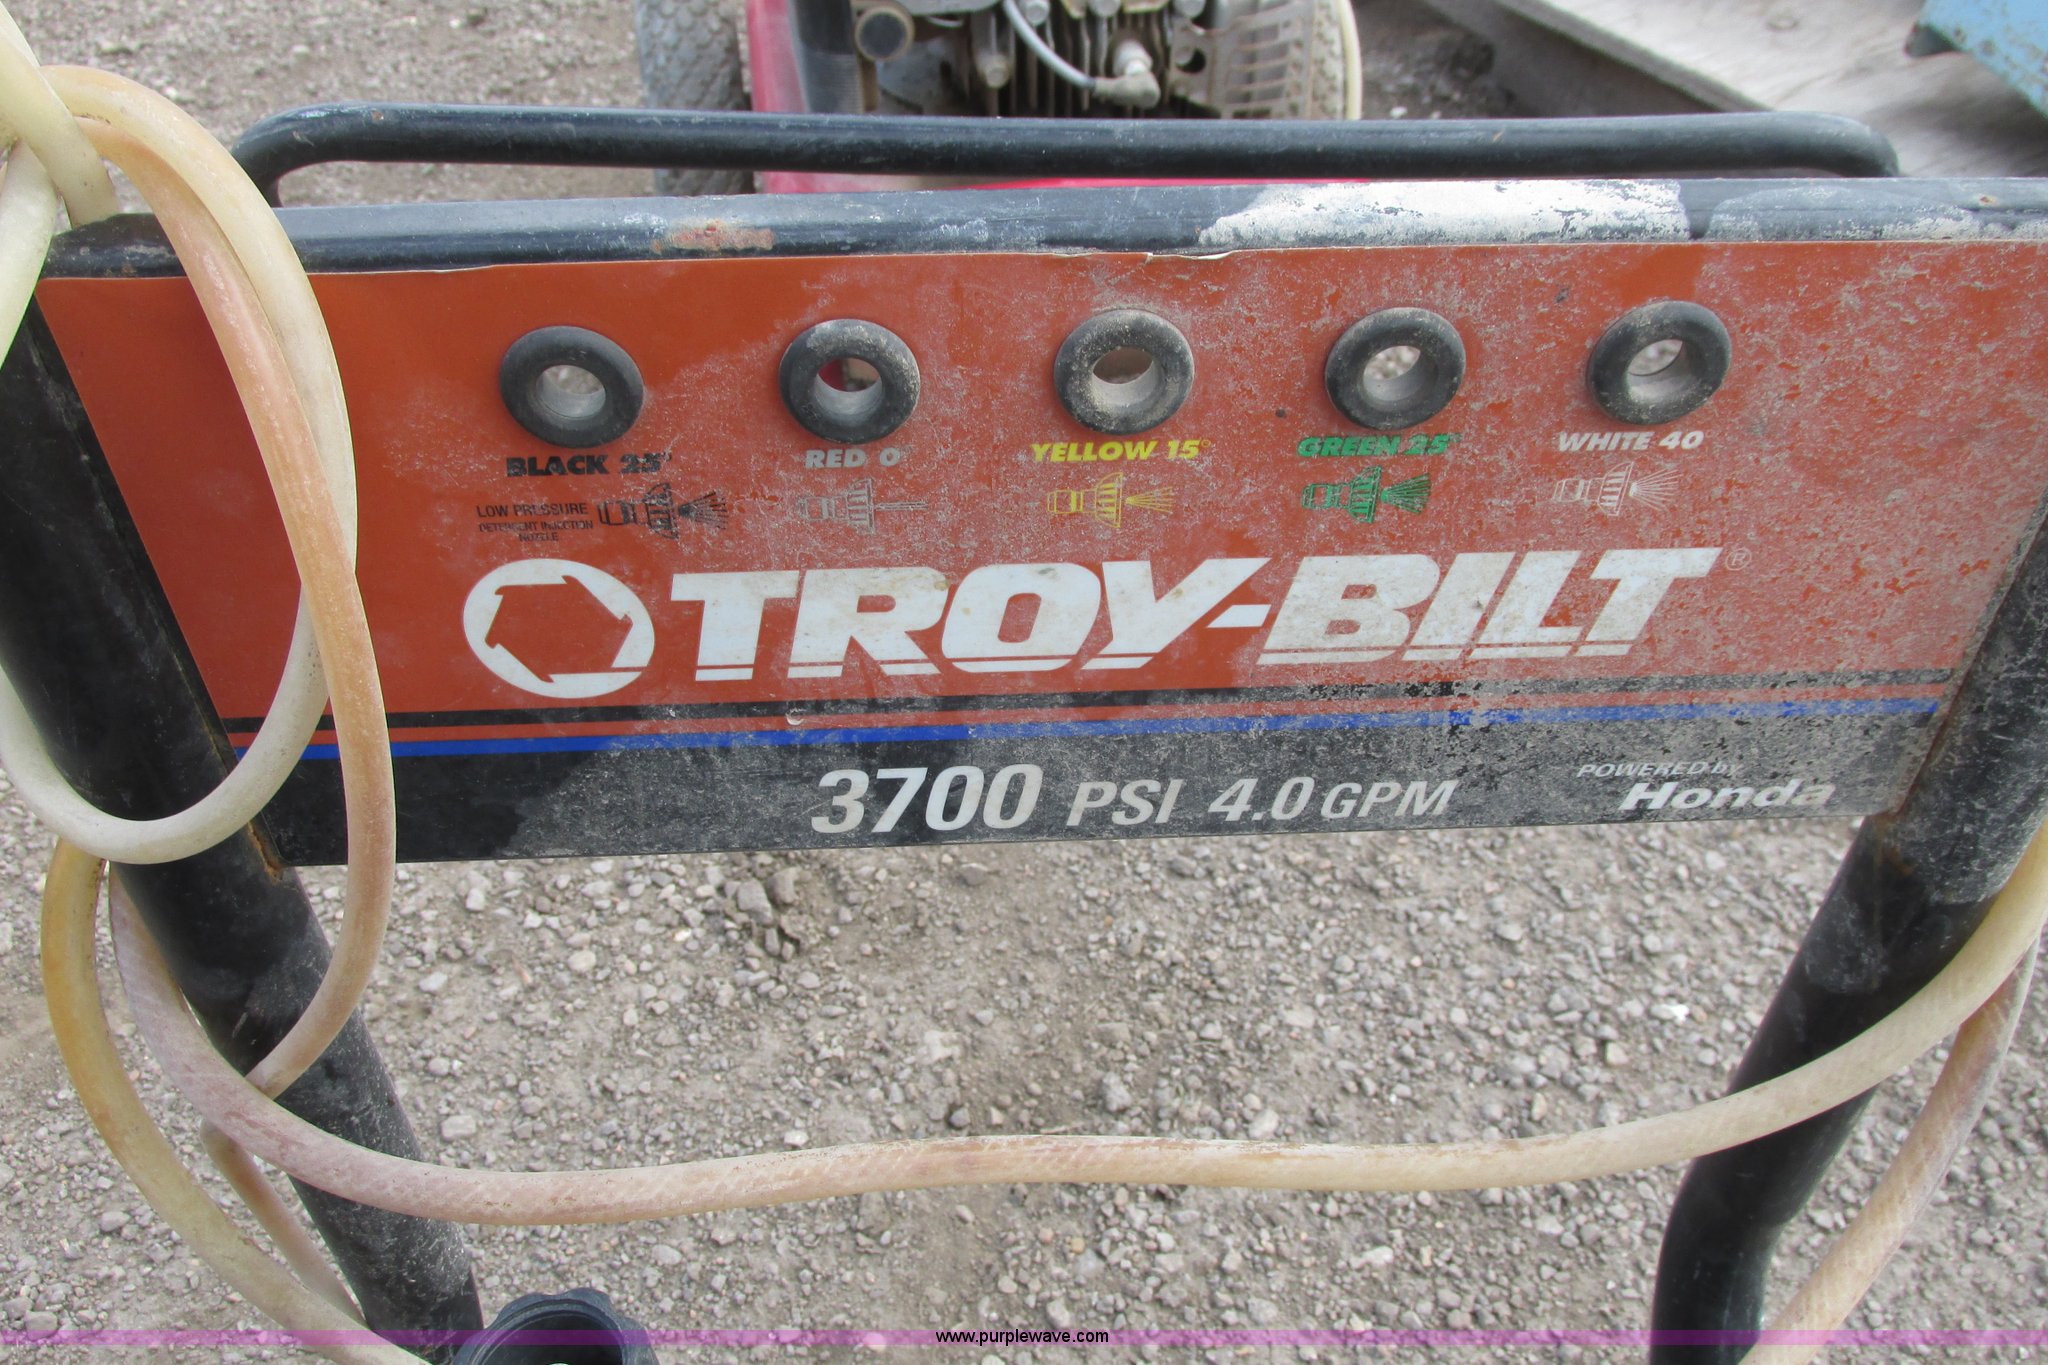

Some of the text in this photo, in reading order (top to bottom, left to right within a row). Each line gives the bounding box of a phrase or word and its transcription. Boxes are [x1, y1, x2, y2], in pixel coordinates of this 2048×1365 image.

[1030, 440, 1158, 463] YELLOW
[1297, 433, 1402, 457] GREEN
[1558, 430, 1656, 452] WHITE
[507, 454, 610, 477] BLACK
[804, 448, 866, 469] RED
[476, 502, 588, 518] LOW PRESSURE
[670, 547, 1723, 682] TROY-BILT
[1577, 761, 1706, 778] POWERED
[810, 764, 1460, 834] 3700 PSI 4.0 GPM
[1618, 778, 1836, 811] Honda
